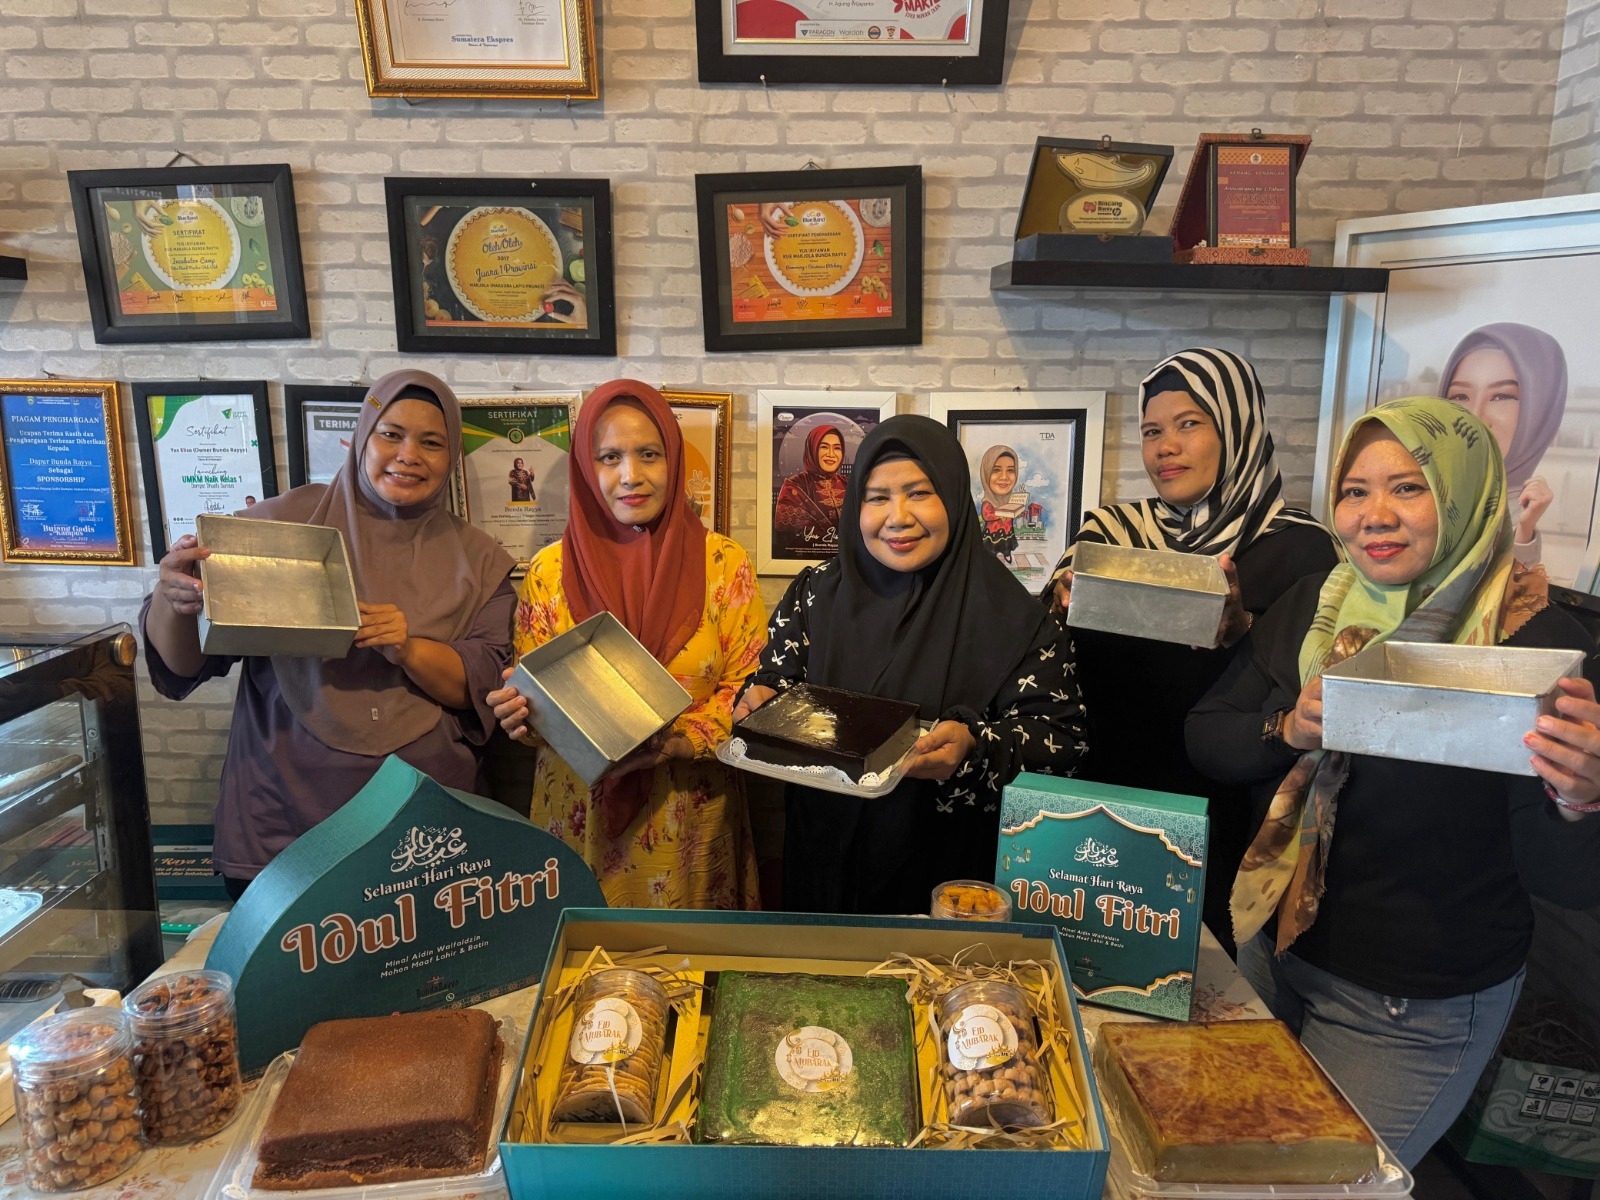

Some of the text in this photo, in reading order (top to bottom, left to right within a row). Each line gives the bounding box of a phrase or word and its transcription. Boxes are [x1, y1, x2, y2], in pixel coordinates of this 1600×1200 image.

[486, 36, 514, 44] Ekspres
[172, 256, 216, 266] Incubator Camp
[476, 268, 499, 282] Juara
[504, 260, 538, 273] Provinsi
[488, 410, 538, 419] SERTIFIKAT
[319, 420, 358, 428] TERIMA
[186, 424, 234, 439] Sertifikat
[30, 458, 49, 466] Dapur
[182, 475, 204, 483] UMKM
[204, 475, 219, 483] Naik
[220, 475, 237, 483] Kelas
[42, 524, 71, 534] Bujang
[822, 526, 839, 542] Elis
[364, 858, 491, 902] Selamat Hari Raya
[1049, 868, 1143, 894] Selamat Hari Raya
[1010, 878, 1180, 940] Idul Fitri
[280, 858, 560, 973] Idul Fitri
[385, 935, 480, 968] Minal Aidin Walfaidzin
[380, 966, 408, 978] Mohon
[412, 957, 433, 968] Maaf
[436, 950, 456, 962] Lahir
[468, 940, 489, 952] Batin
[598, 1020, 610, 1030] EID
[972, 1026, 984, 1036] EID
[584, 1028, 622, 1042] MUBARAK
[962, 1034, 998, 1050] MUBARAK
[808, 1048, 820, 1058] EID
[794, 1058, 832, 1068] MUBARAK
